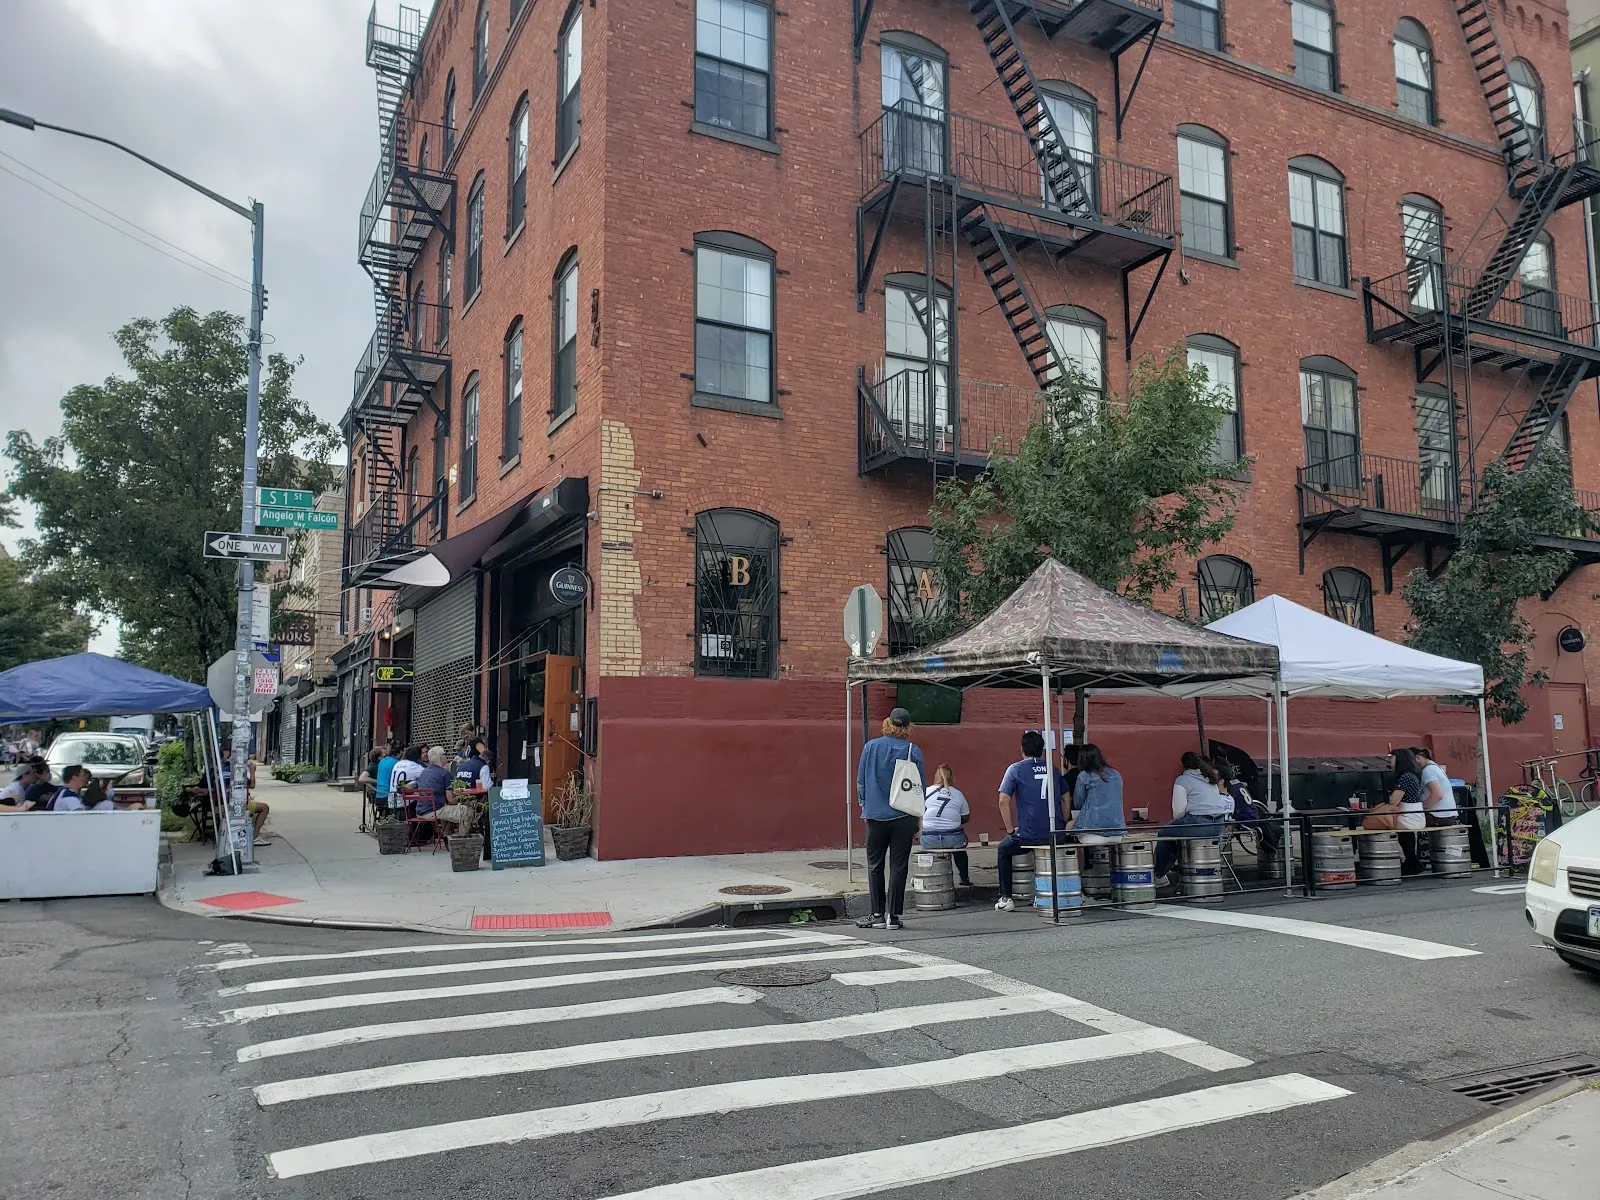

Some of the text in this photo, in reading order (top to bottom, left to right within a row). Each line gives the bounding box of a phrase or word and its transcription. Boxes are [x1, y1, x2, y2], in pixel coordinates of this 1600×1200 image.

[269, 491, 303, 505] S 1 St
[262, 509, 337, 523] Angelo M Falcón
[218, 540, 277, 553] ONE WAY
[729, 555, 751, 586] B
[915, 571, 934, 599] A
[555, 581, 584, 593] GUINNESS
[1031, 765, 1047, 773] SON
[1034, 773, 1048, 800] 7
[1239, 787, 1253, 805] 8
[491, 799, 532, 810] Cocktails
[936, 796, 952, 818] 7
